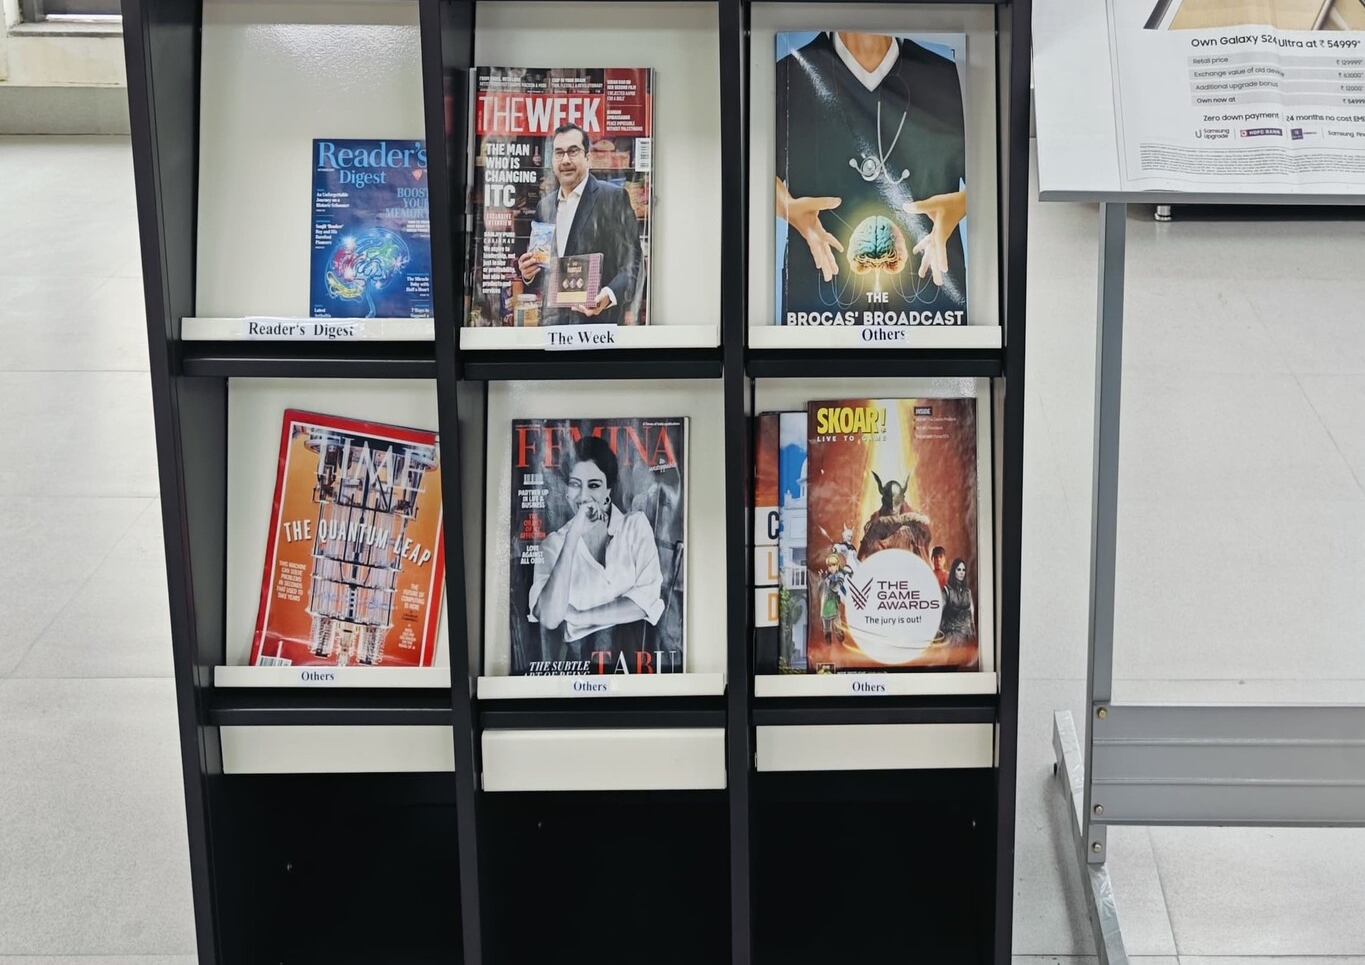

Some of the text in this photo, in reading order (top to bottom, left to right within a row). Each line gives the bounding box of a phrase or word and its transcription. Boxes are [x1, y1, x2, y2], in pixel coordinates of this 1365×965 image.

[1203, 112, 1279, 122] Zero down payment
[318, 141, 427, 168] Reader's
[339, 170, 386, 188] Digest
[485, 170, 536, 183] CHANGING
[484, 185, 516, 207] ITC
[864, 311, 964, 325] BROADCAST
[249, 321, 353, 340] Reader's Digest
[862, 327, 905, 342] Others
[548, 331, 614, 345] The Week
[817, 407, 886, 434] SKOAR!
[284, 519, 432, 567] THE QUANTUM LEAP
[877, 591, 920, 600] GAME
[877, 600, 940, 610] AWARDS
[865, 615, 922, 626] The jury out!
[301, 671, 334, 681] Others
[574, 681, 607, 692] Others
[852, 682, 885, 692] Others
